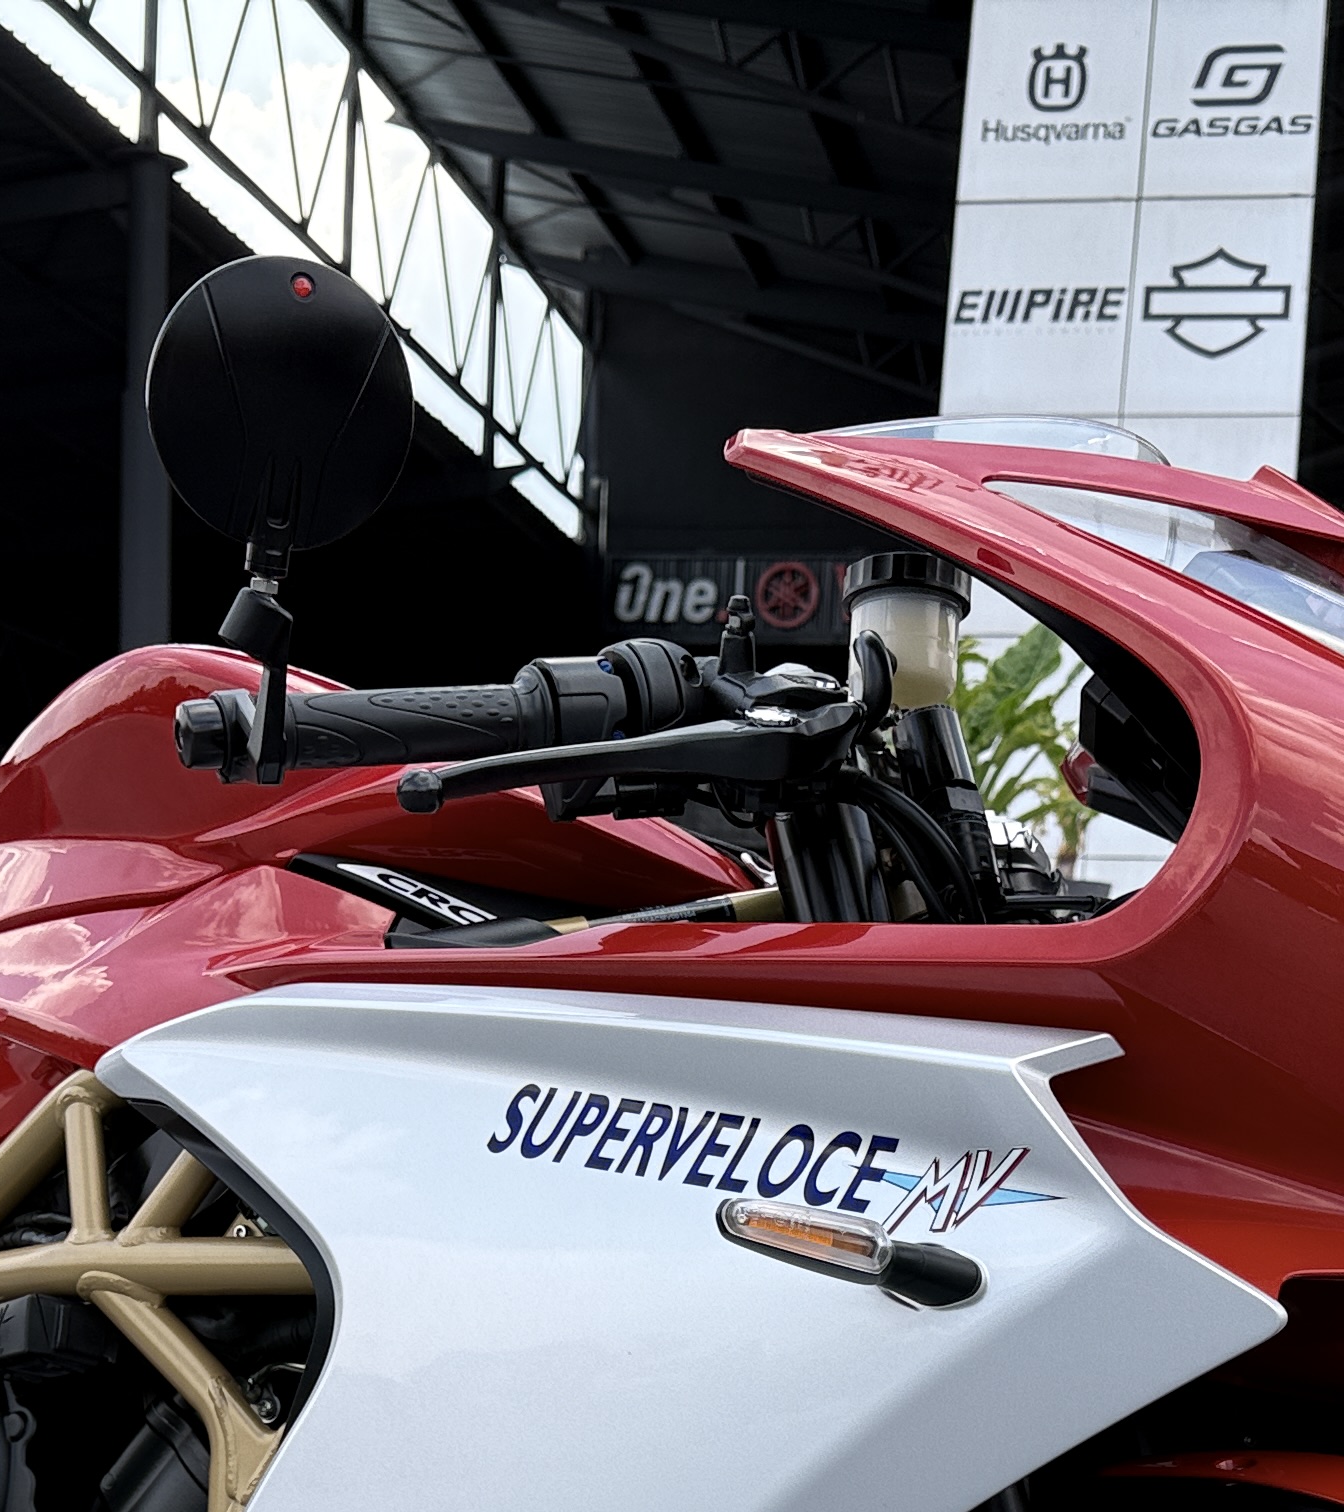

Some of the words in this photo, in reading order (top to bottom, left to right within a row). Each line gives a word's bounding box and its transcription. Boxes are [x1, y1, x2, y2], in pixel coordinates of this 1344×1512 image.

[981, 118, 1126, 146] Husqvarna
[1150, 115, 1314, 138] GASGAS
[486, 1083, 901, 1211] SUPERVELOCE
[884, 1147, 1032, 1236] MV
